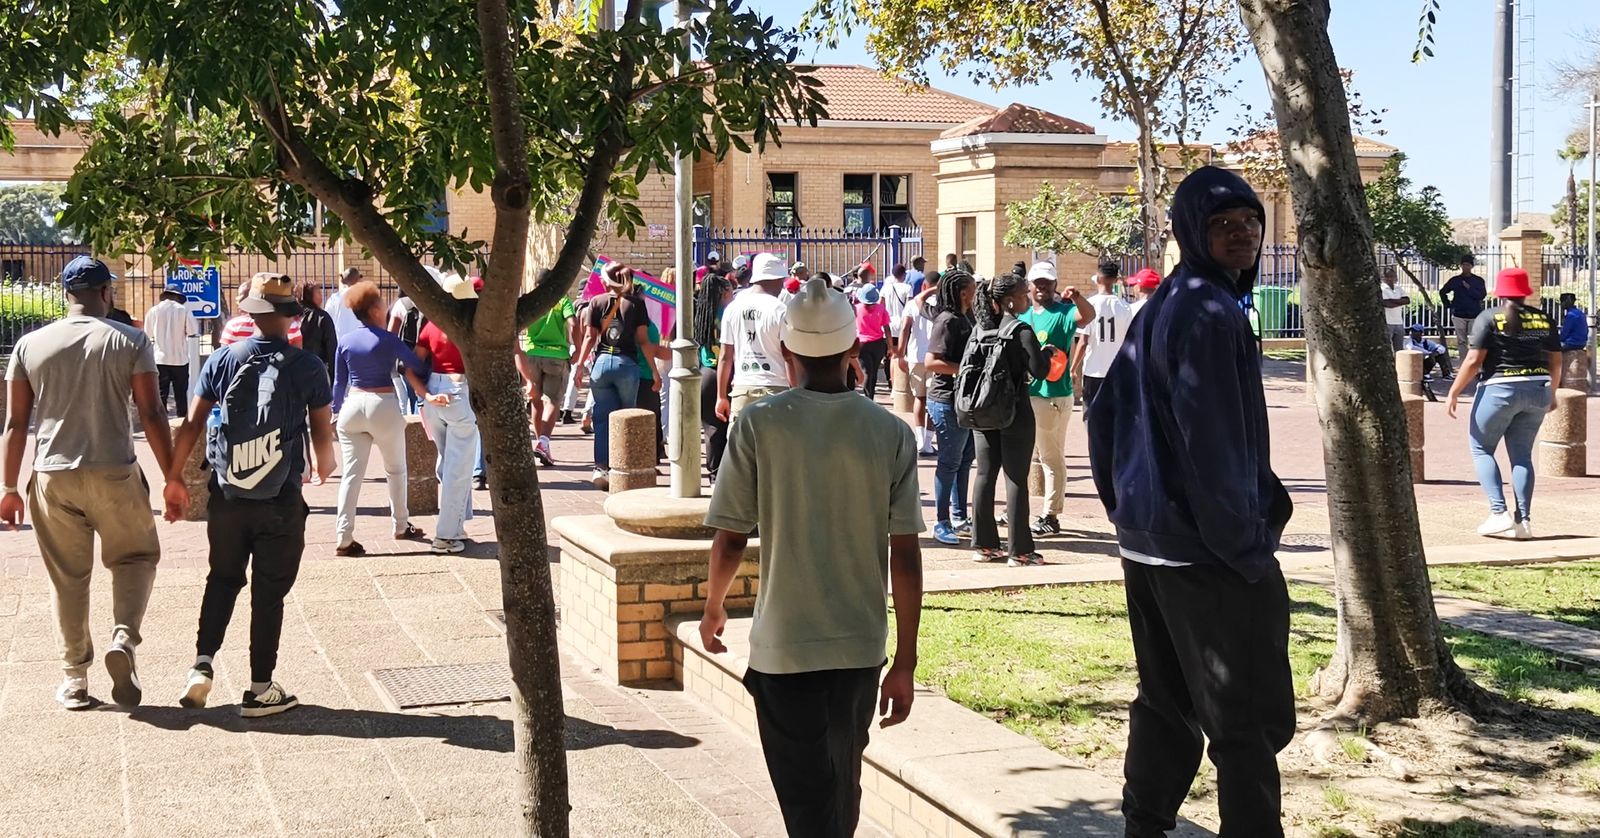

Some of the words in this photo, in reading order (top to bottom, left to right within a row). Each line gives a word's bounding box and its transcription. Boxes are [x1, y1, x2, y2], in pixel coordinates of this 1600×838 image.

[182, 282, 204, 293] ZONE
[651, 286, 676, 303] SHIEL
[1098, 316, 1115, 342] 11
[232, 428, 282, 473] NIKE
